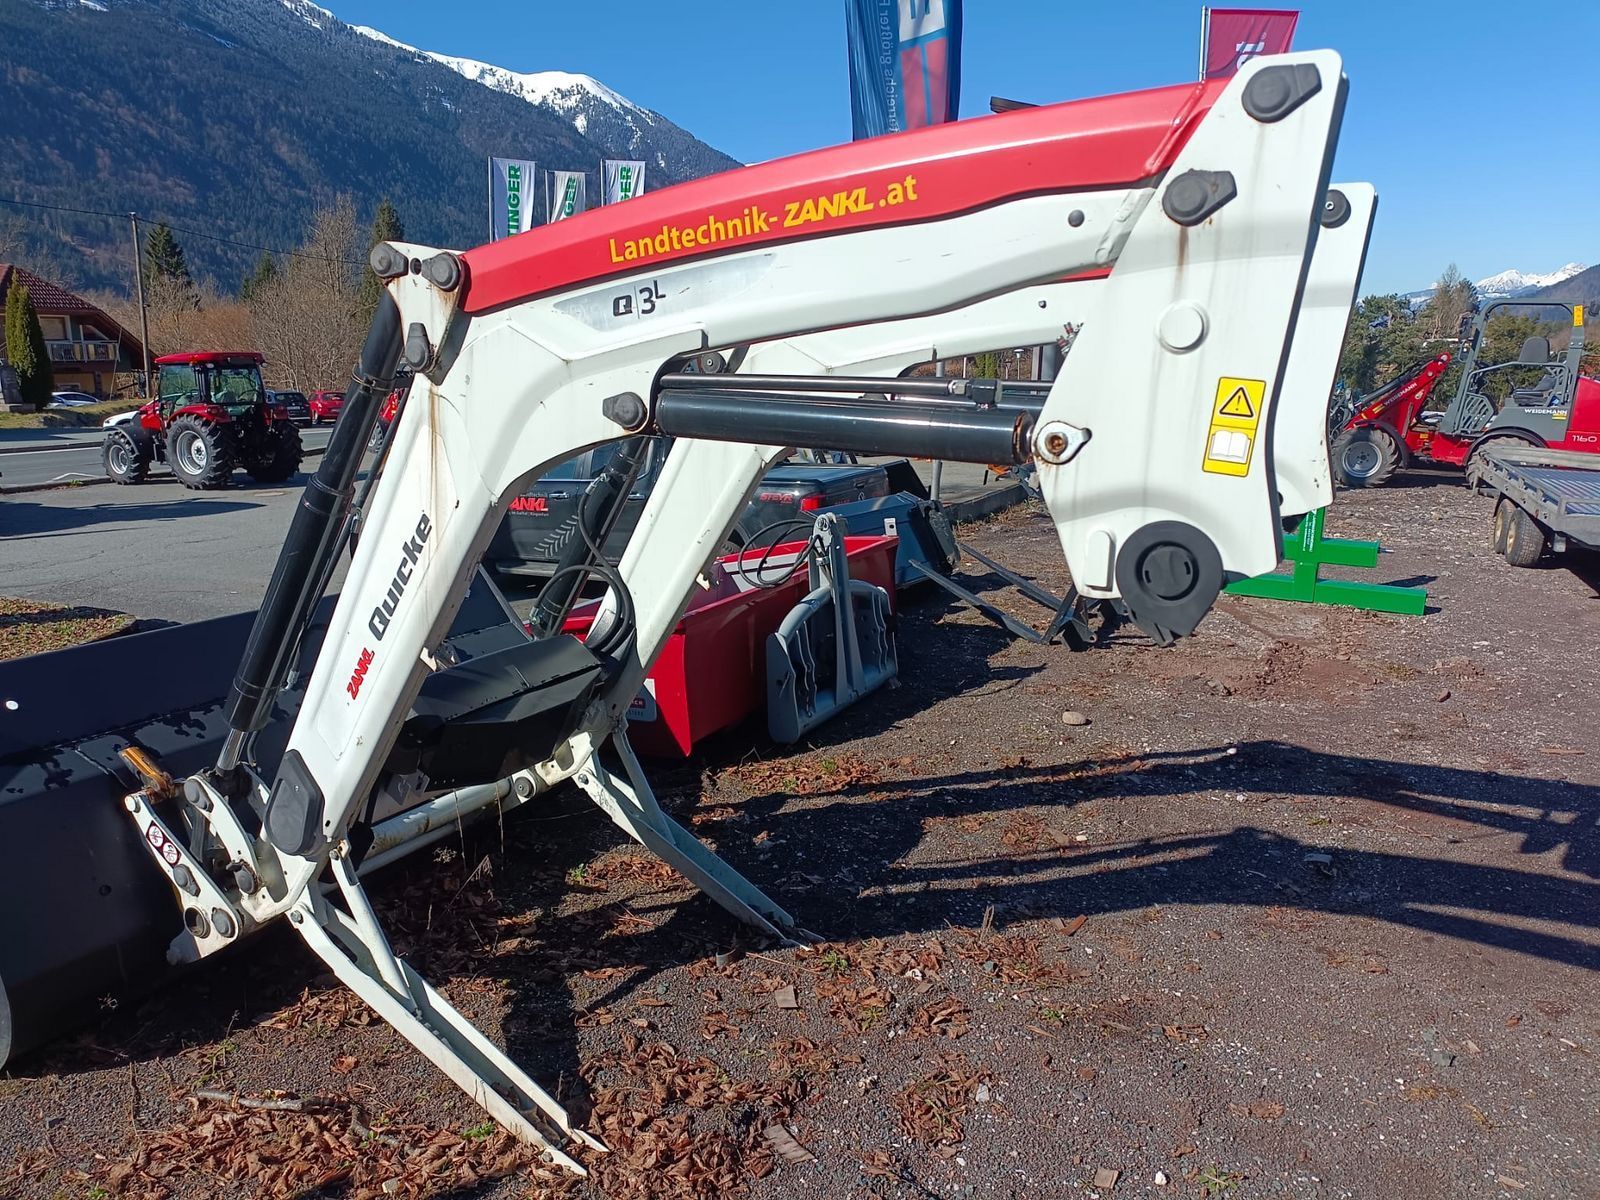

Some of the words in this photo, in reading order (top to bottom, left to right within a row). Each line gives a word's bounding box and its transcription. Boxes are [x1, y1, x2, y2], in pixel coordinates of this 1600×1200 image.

[1524, 408, 1568, 416] WEIDEMANN
[760, 492, 793, 502] STEYR
[368, 513, 432, 641] Quicke
[347, 647, 375, 700] ZANKL
